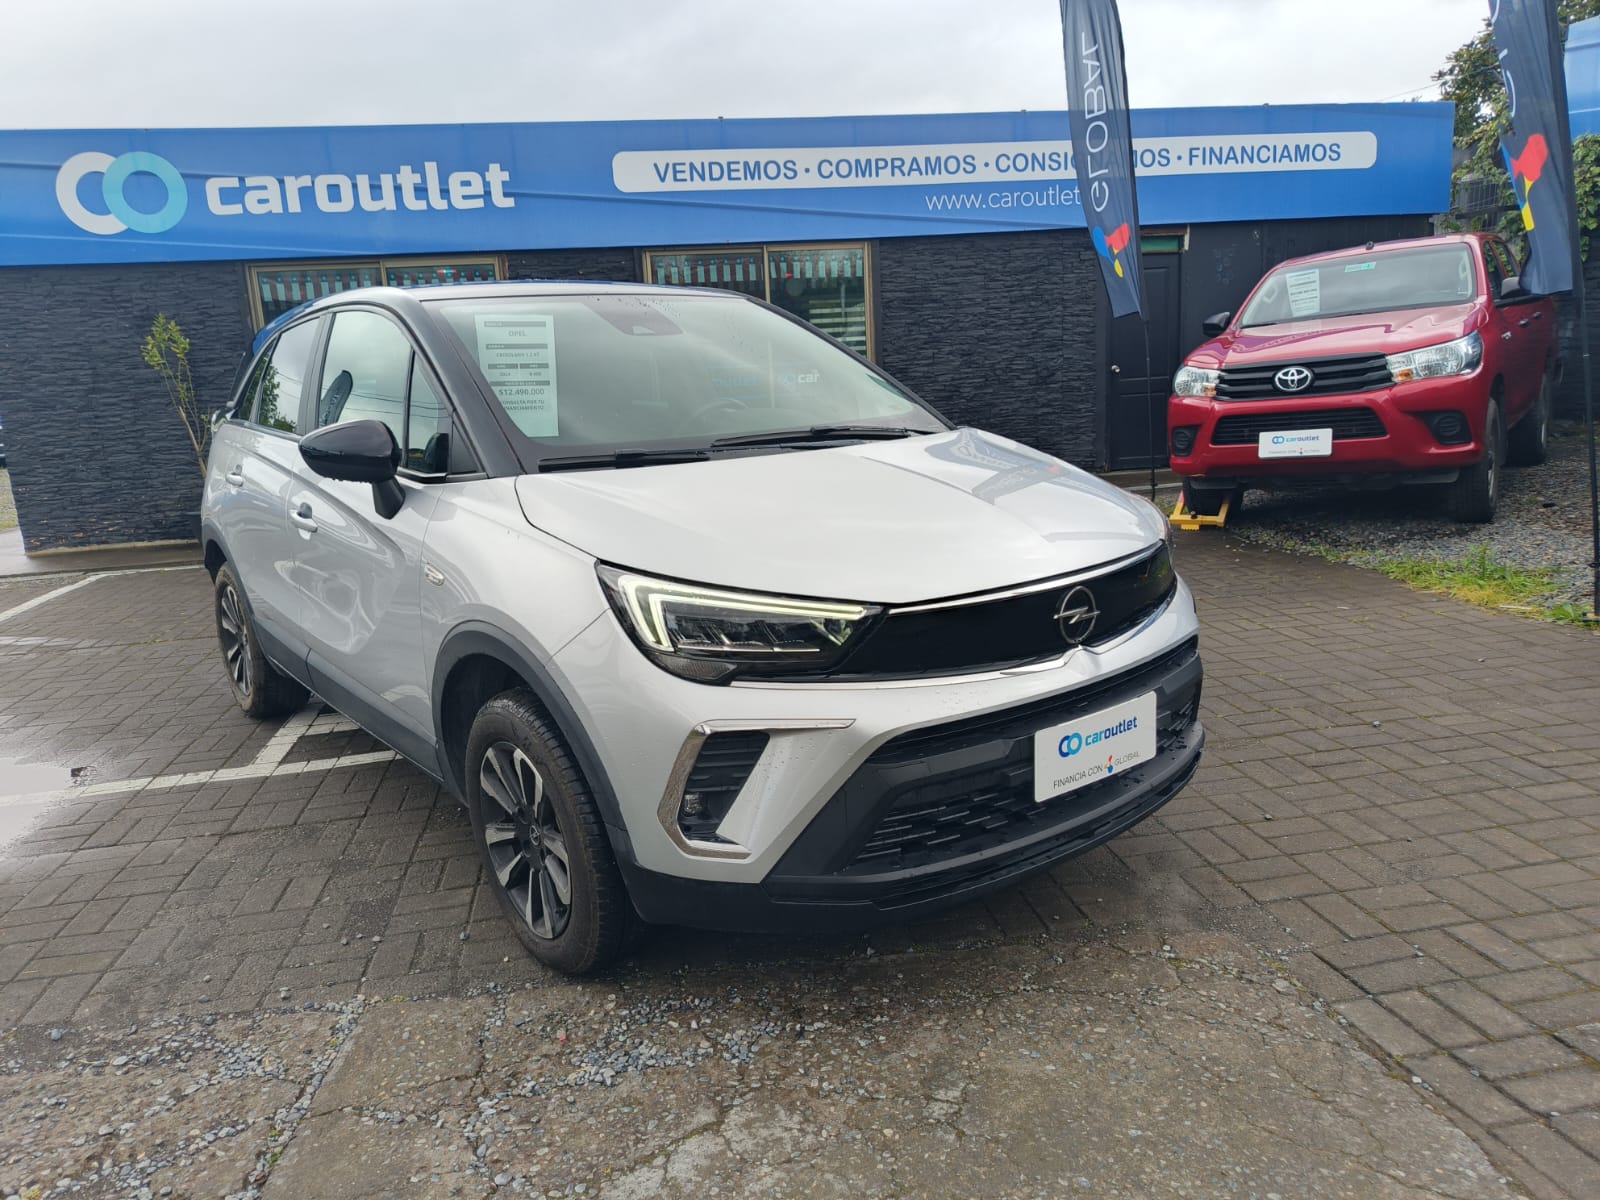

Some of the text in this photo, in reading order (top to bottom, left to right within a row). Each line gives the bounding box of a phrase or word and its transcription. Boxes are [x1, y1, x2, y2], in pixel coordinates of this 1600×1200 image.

[653, 143, 1342, 184] VENDEMOS COMPRAMOS CONSIOS FINANCIAMOS
[205, 161, 515, 216] caroutlet
[1085, 716, 1138, 747] caroutlet
[1053, 751, 1140, 790] FINANCIA CON GLOBAL
